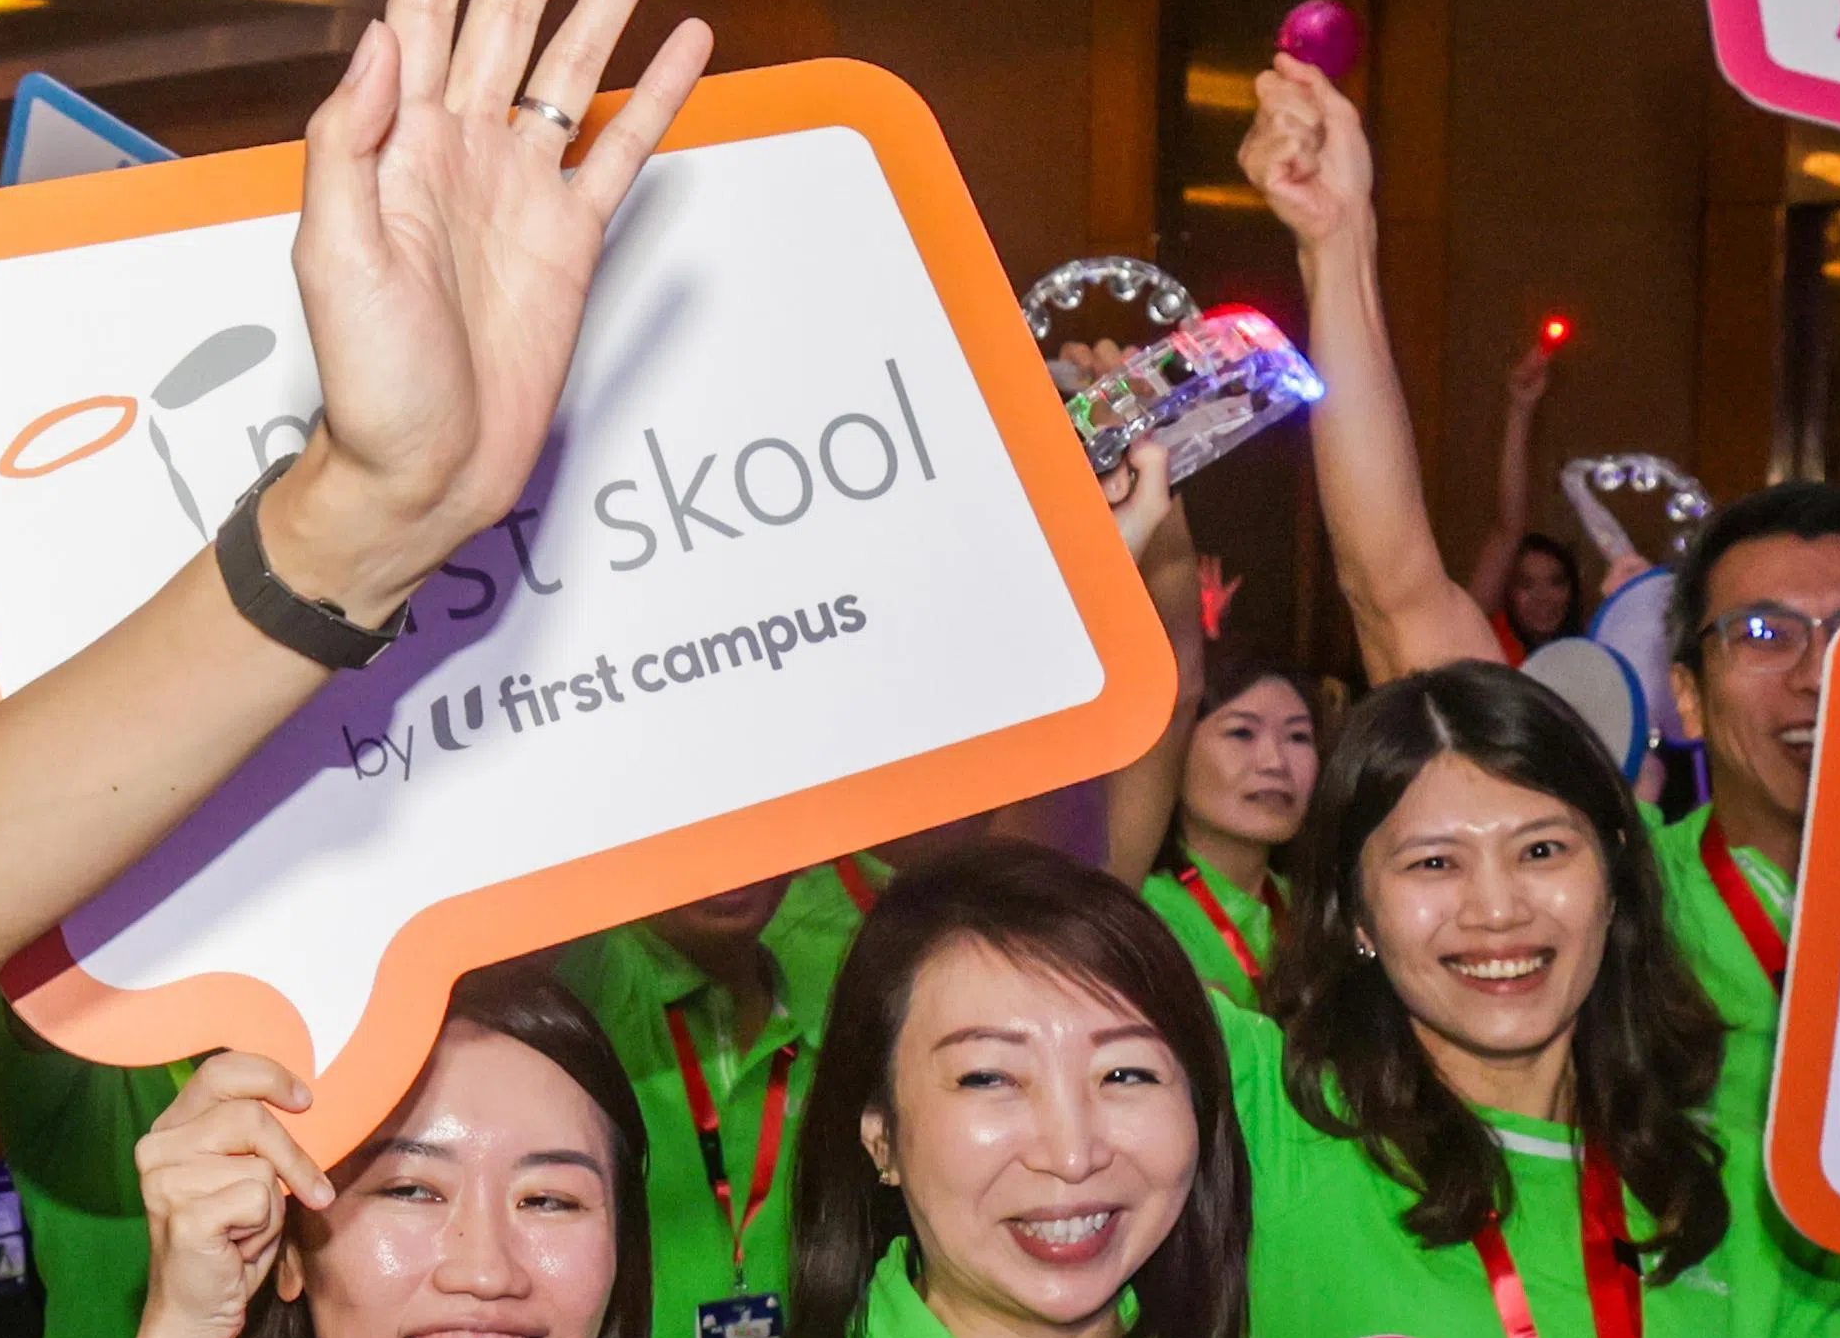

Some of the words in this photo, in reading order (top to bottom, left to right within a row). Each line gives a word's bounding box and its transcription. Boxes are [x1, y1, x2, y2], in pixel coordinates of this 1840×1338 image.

[593, 358, 937, 573] skool
[342, 724, 415, 782] by
[497, 654, 625, 734] first
[631, 593, 867, 695] campus
